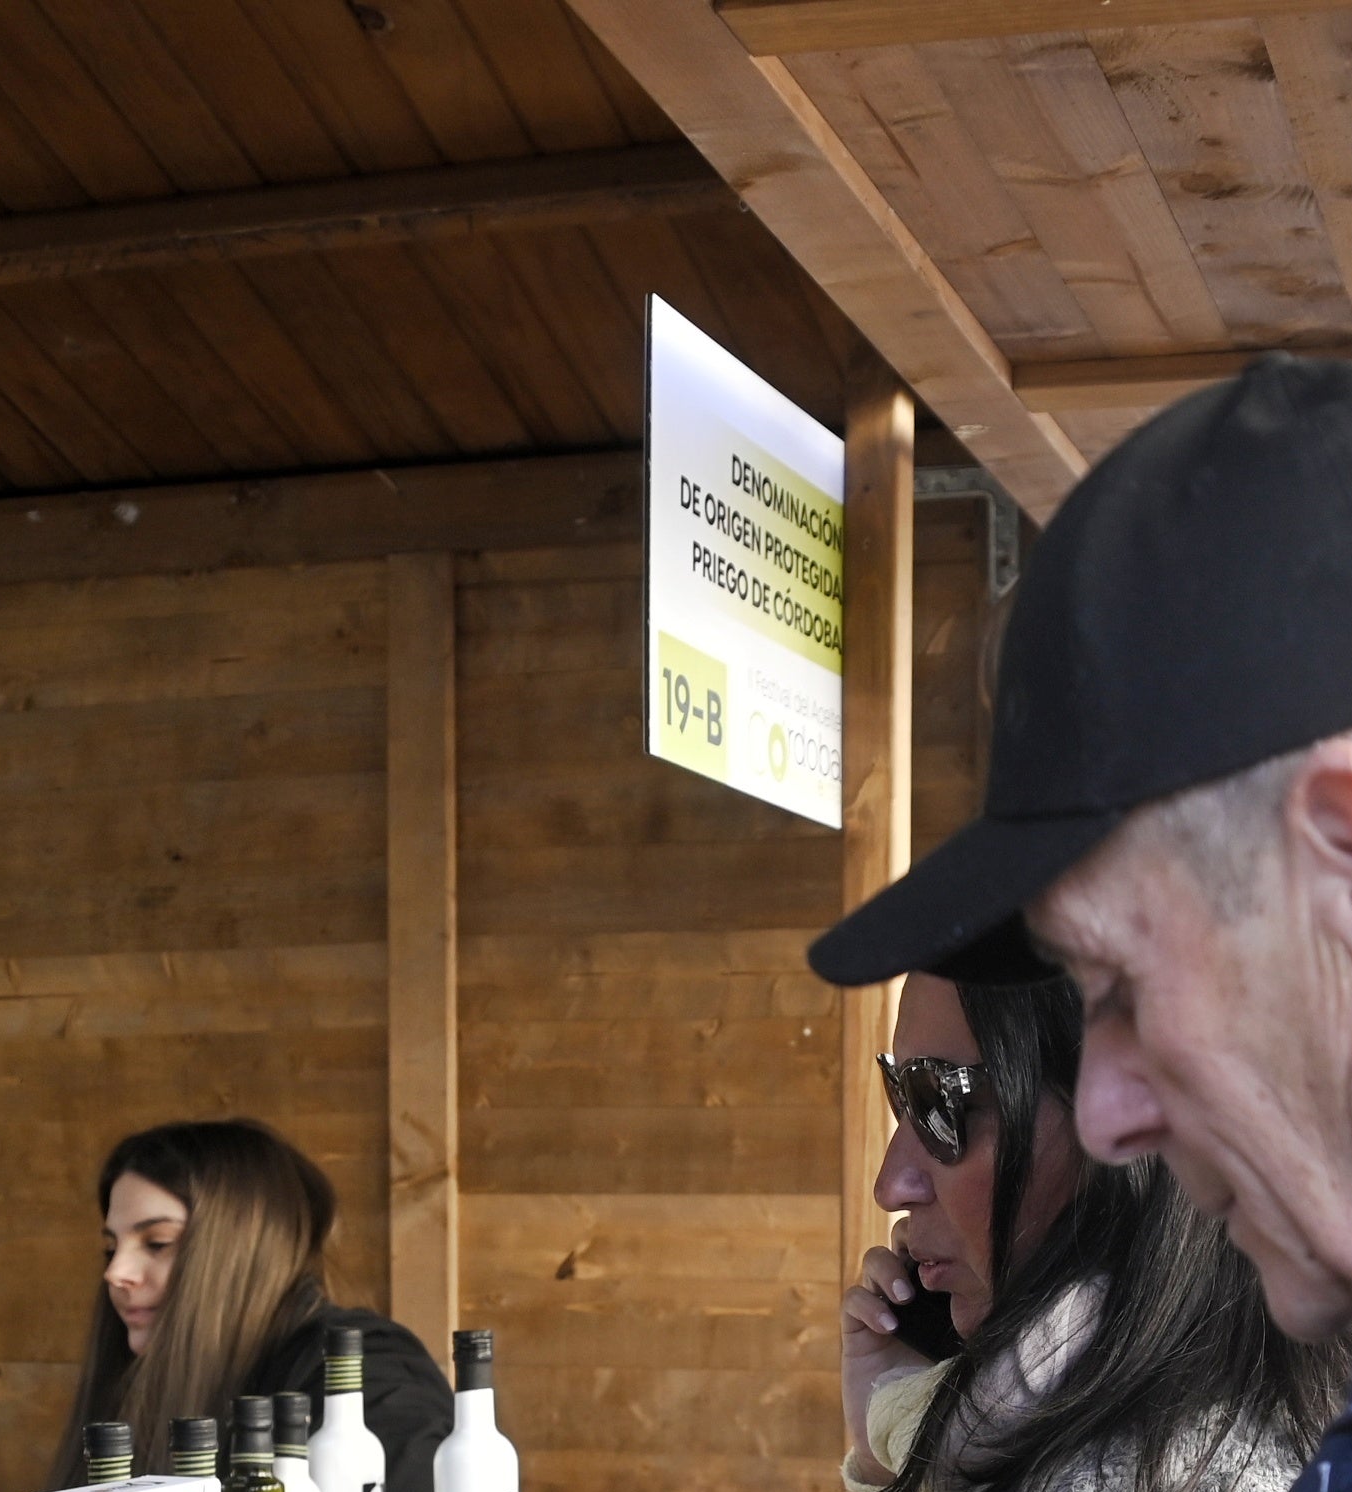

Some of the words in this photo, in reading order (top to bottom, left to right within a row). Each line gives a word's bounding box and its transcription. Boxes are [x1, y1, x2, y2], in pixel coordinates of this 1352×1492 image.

[680, 474, 701, 518] DE
[704, 492, 761, 556] ORIGEN
[765, 529, 844, 606] PROTEGIDA
[732, 453, 843, 554] DENOMINACIÓN
[693, 540, 748, 601] PRIEGO
[752, 576, 770, 615] DE
[773, 587, 843, 656] CÓRDOBA
[662, 667, 723, 746] 19-B
